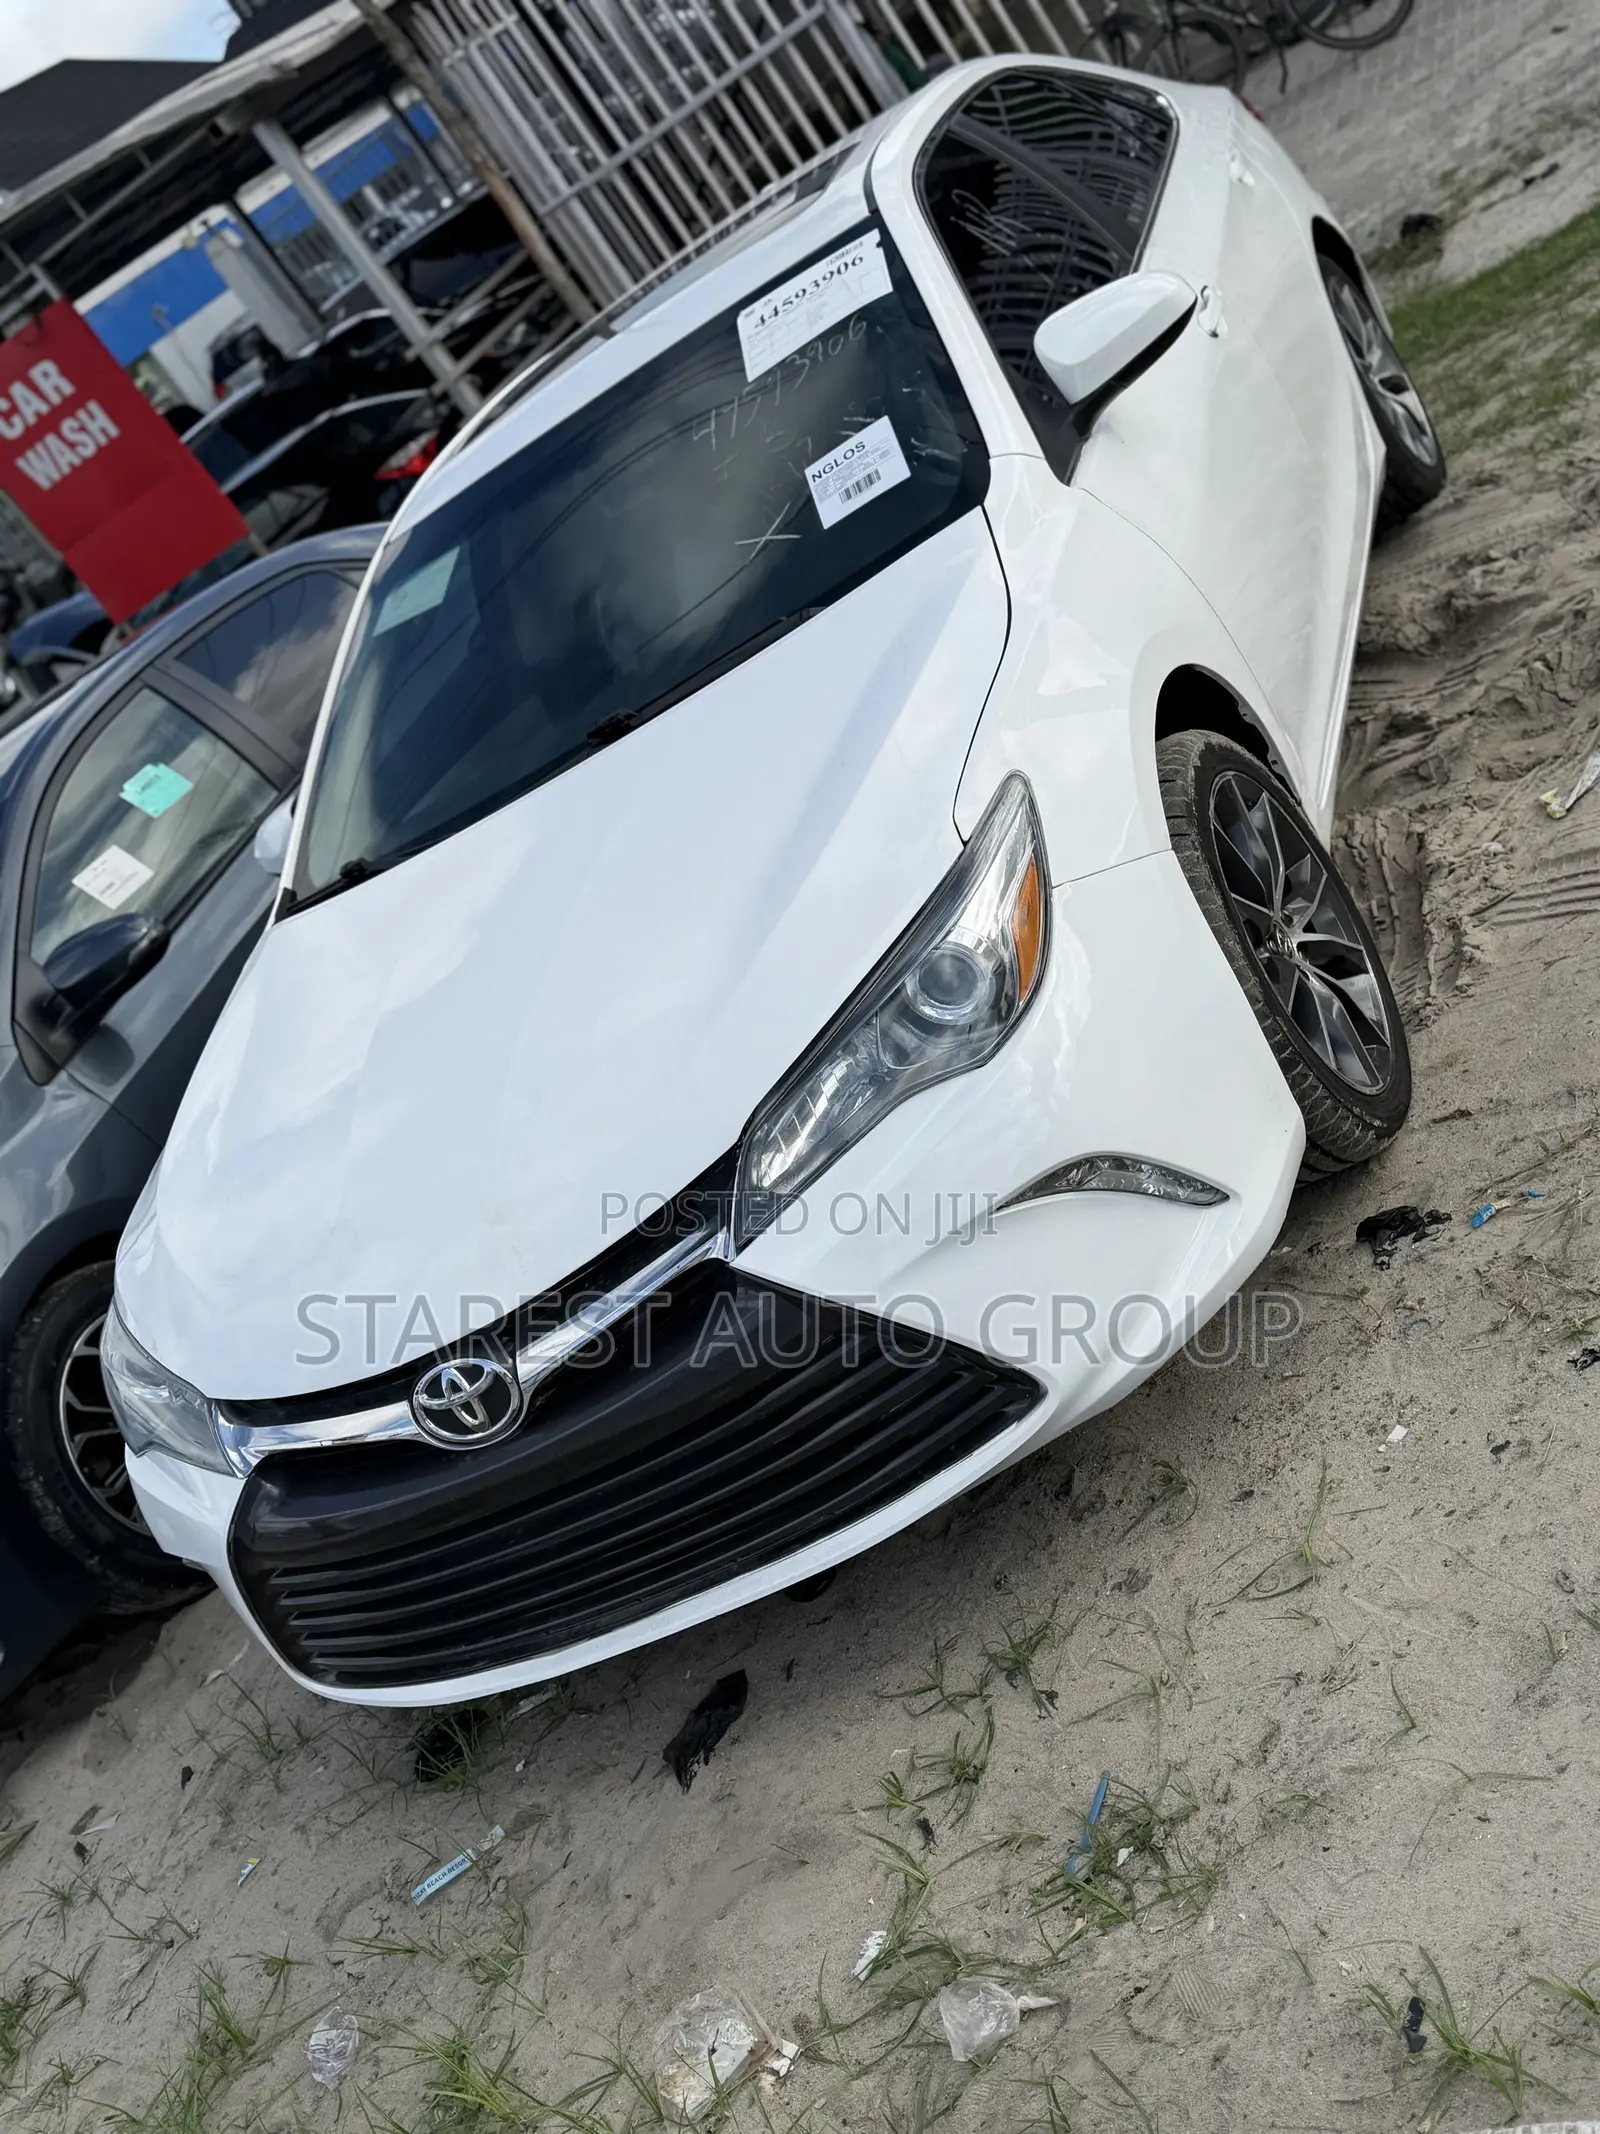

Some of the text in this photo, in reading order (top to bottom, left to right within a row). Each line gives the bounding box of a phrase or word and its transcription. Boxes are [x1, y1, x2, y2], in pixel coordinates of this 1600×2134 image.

[754, 253, 864, 330] 44593906
[0, 358, 77, 441] CAR
[14, 398, 120, 491] WASH
[811, 441, 866, 483] NGLOS
